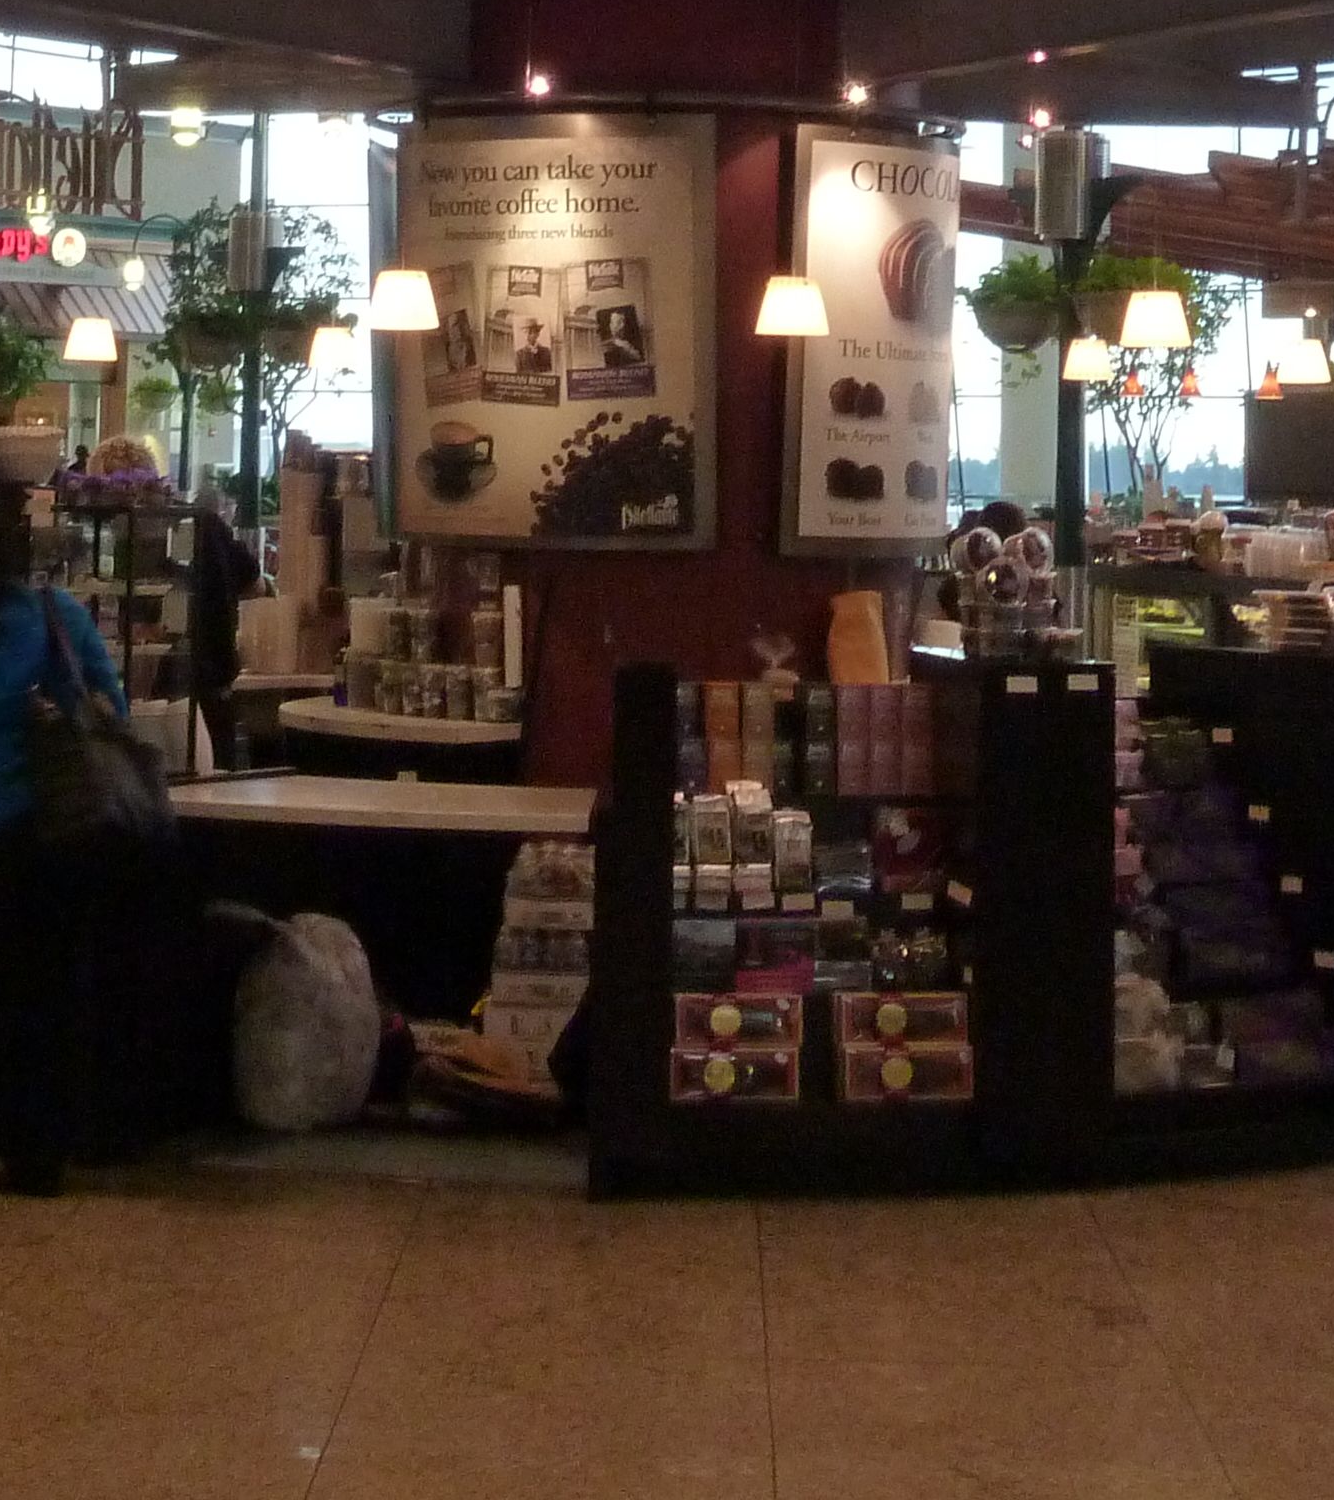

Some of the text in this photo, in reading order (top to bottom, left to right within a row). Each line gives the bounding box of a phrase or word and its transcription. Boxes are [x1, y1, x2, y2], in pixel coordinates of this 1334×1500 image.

[462, 166, 497, 190] you
[503, 163, 540, 181] can
[547, 155, 594, 180] take
[601, 161, 657, 187] your
[429, 188, 640, 217] favorite coffee home.
[508, 225, 538, 240] three
[541, 230, 568, 240] new
[571, 223, 614, 239] blends
[839, 338, 871, 359] The
[827, 428, 847, 442] The
